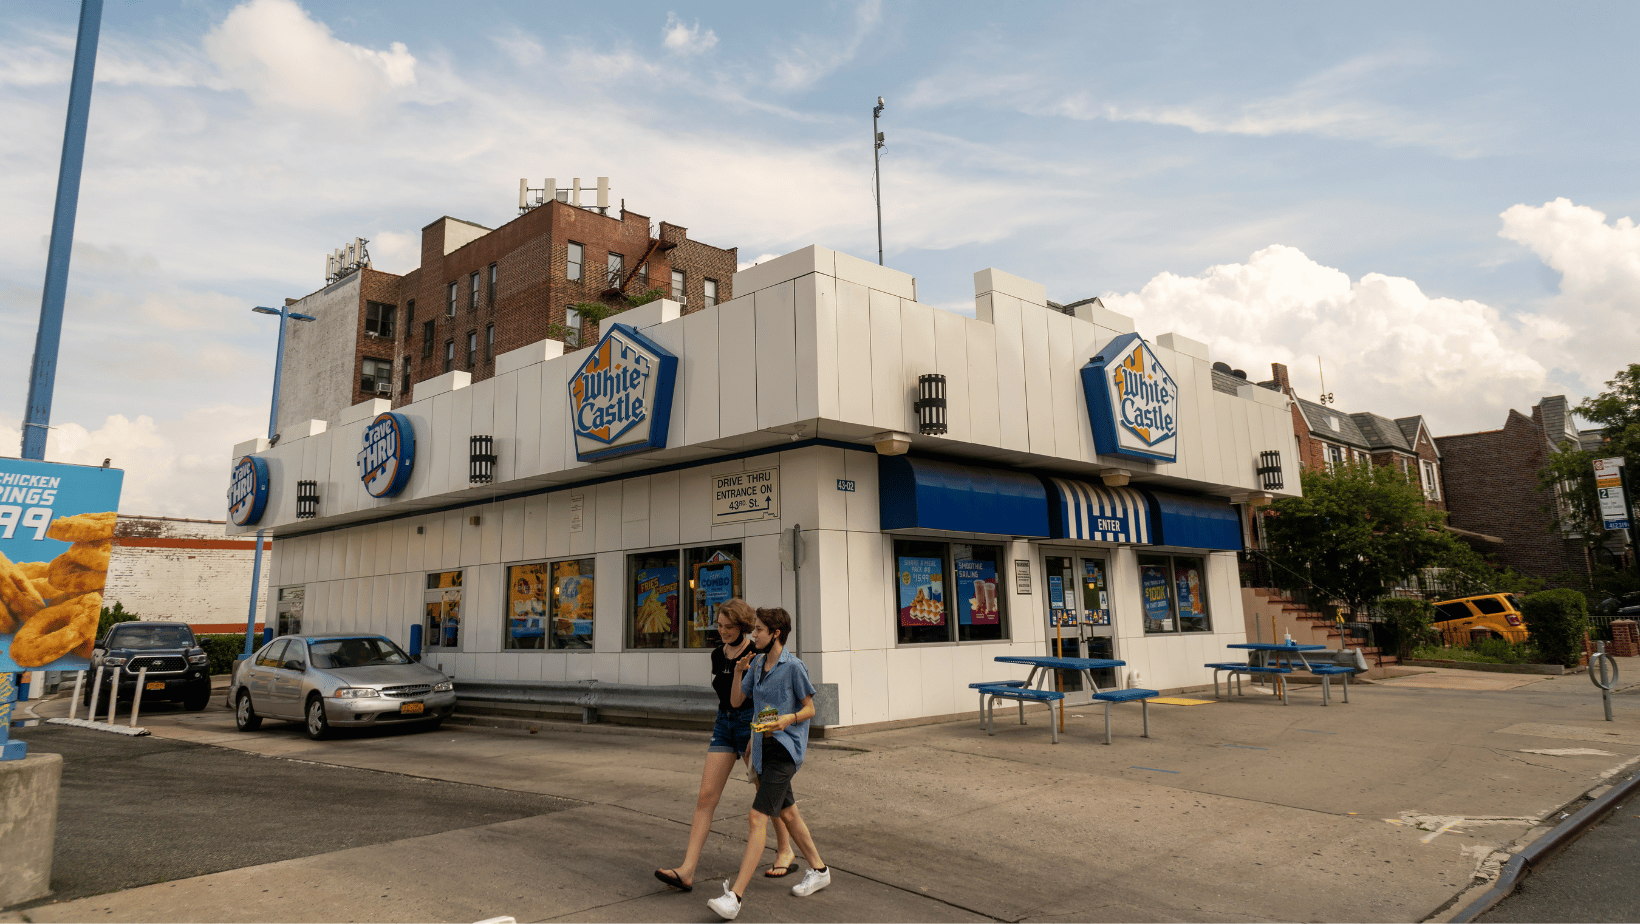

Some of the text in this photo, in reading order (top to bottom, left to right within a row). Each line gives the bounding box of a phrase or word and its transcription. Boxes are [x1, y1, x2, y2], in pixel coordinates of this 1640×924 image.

[582, 364, 641, 404] White
[1122, 368, 1169, 406] White
[577, 392, 644, 432] Castle
[1121, 397, 1174, 433] Castle
[361, 419, 392, 449] Crave
[356, 430, 395, 480] THRU
[717, 471, 771, 488] DRIVE THRU
[837, 480, 855, 491] 43-02
[0, 486, 58, 506] INGS
[227, 471, 254, 509] THRU
[716, 484, 773, 500] ENTRANCE ON
[1601, 489, 1607, 498] 2
[748, 498, 760, 508] St.
[1097, 518, 1121, 532] ENTER
[958, 562, 983, 570] SMOOTHIE
[640, 580, 659, 593] FRIES
[701, 577, 730, 588] COMBO
[1145, 585, 1166, 602] $100K
